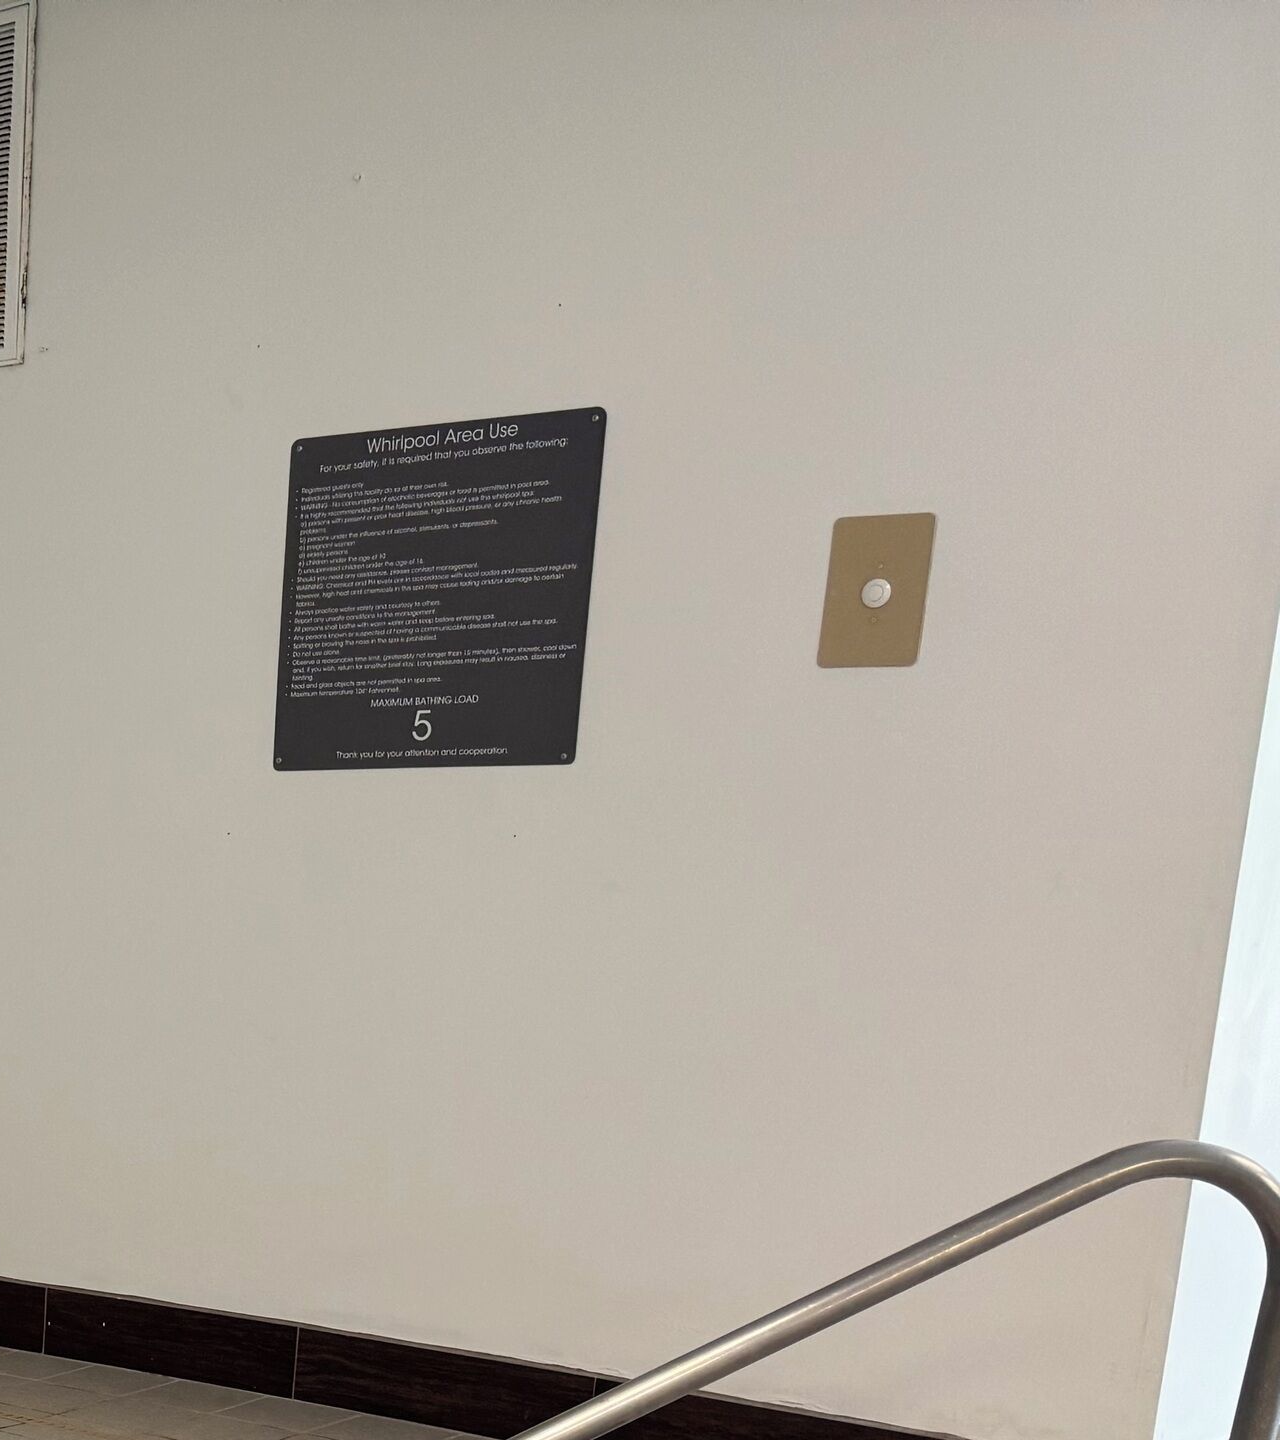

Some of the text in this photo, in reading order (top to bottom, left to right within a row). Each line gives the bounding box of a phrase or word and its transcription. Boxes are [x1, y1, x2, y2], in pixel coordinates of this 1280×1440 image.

[366, 422, 518, 453] Whirlpool Area Use
[319, 464, 332, 472] For
[333, 463, 351, 472] your
[353, 459, 379, 469] safety,
[381, 457, 387, 466] it
[388, 457, 395, 465] is
[396, 451, 432, 464] required
[434, 449, 451, 459] that
[453, 449, 470, 459] you
[471, 444, 507, 455] observe
[508, 442, 524, 451] the
[370, 694, 479, 707] MAXIMUM BATHING LOAD
[411, 709, 431, 741] 5
[335, 750, 358, 758] Thank
[359, 751, 373, 759] you
[386, 750, 403, 759] your
[404, 748, 439, 757] attention
[440, 747, 457, 756] and
